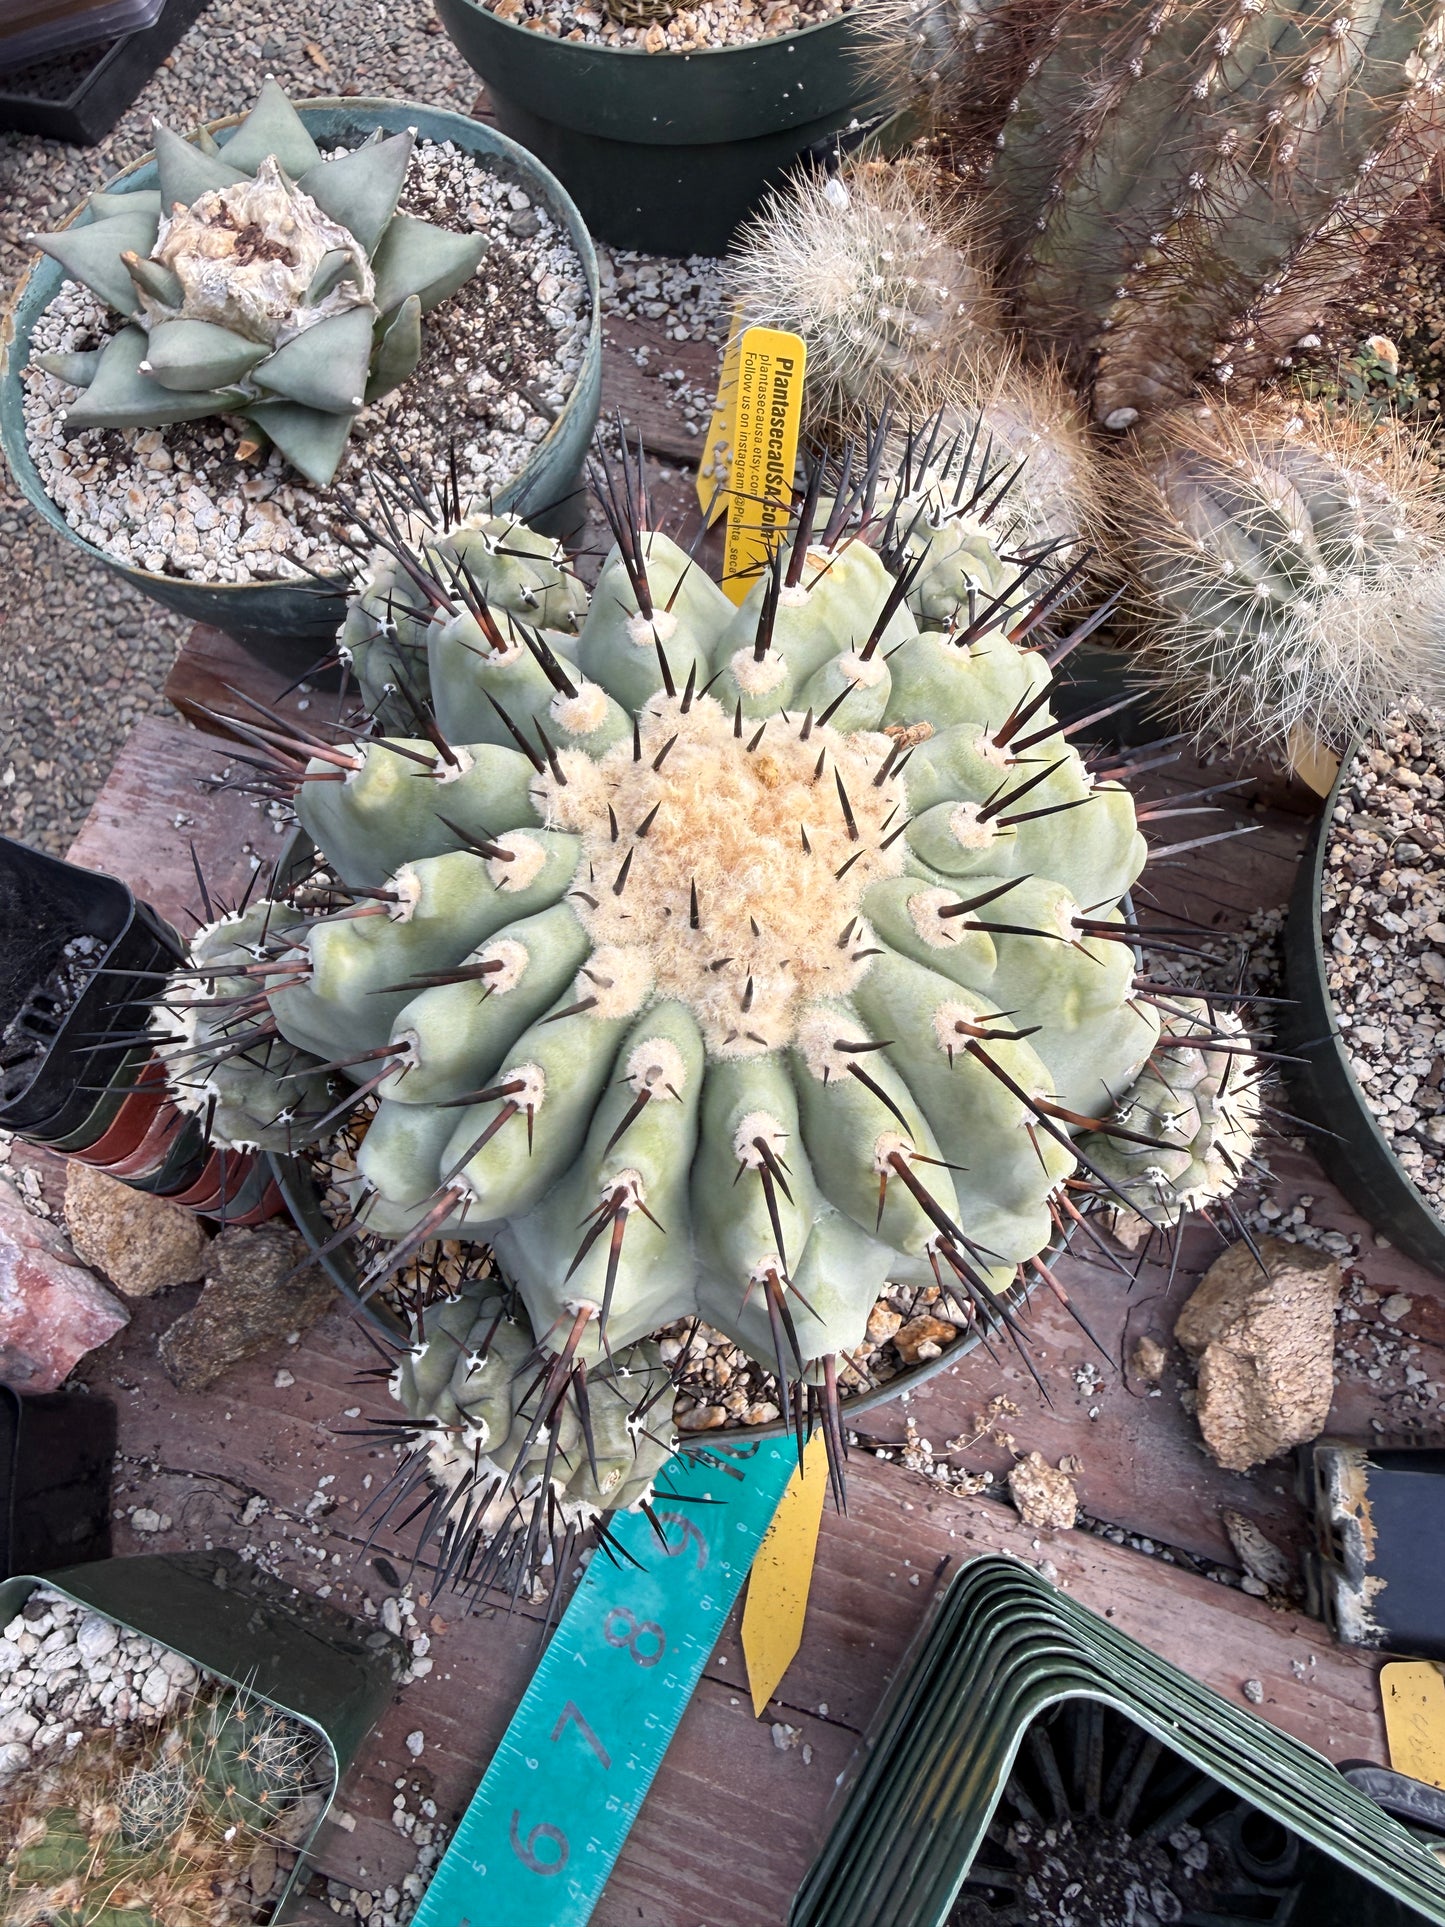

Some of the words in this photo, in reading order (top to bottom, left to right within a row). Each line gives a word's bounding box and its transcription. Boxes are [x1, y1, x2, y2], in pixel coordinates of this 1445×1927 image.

[742, 352, 757, 393] Follow
[741, 395, 751, 410] us
[740, 413, 749, 428] on
[760, 357, 795, 539] PlantasecaUSA.com
[700, 1594, 714, 1611] 10
[683, 1633, 697, 1648] 11
[663, 1673, 678, 1689] 12
[509, 1808, 570, 1877] 6
[550, 1700, 612, 1770] 7
[604, 1606, 666, 1668] 8
[652, 1512, 709, 1570] 9
[644, 1712, 659, 1729] 13
[472, 1860, 487, 1876] 5
[573, 1653, 587, 1667] 7
[625, 1753, 640, 1770] 14
[605, 1794, 621, 1813] 15
[586, 1836, 601, 1854] 16
[567, 1879, 582, 1900] 17
